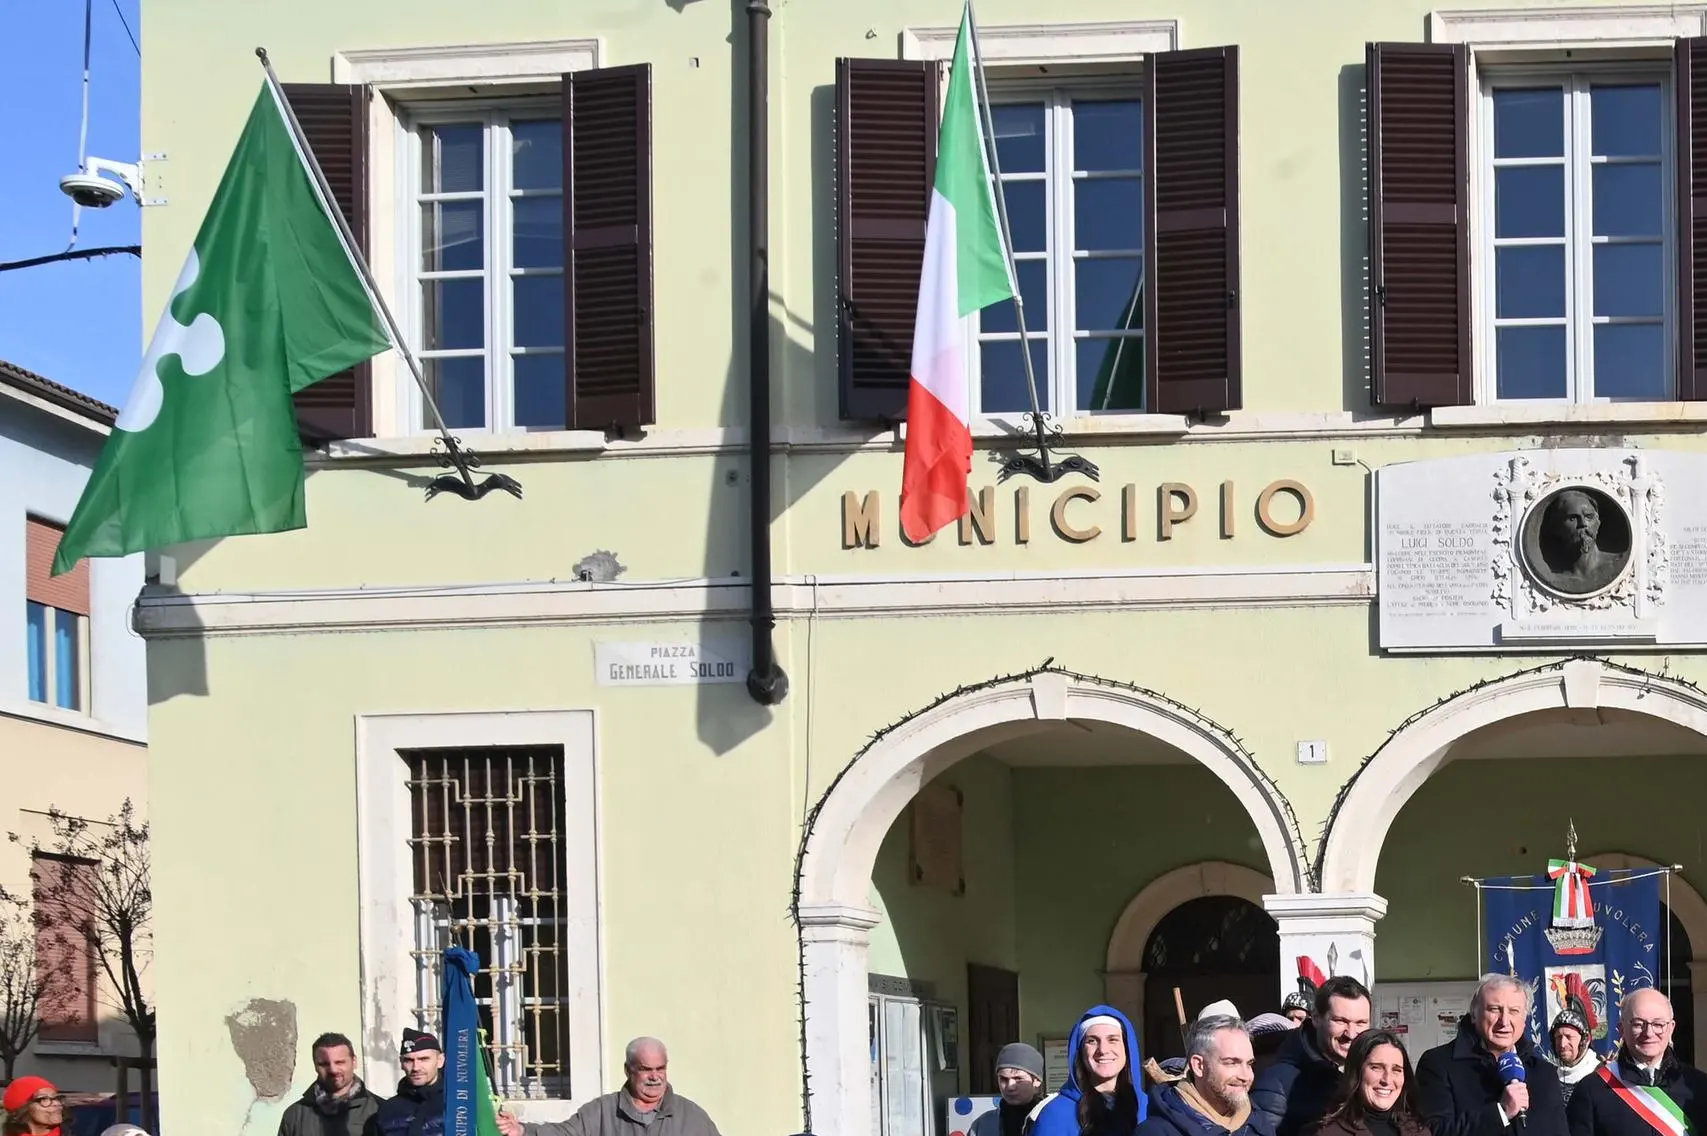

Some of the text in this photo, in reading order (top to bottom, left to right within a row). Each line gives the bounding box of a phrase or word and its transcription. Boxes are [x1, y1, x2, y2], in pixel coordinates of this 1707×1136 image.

[843, 478, 1315, 549] MNICIPIO
[651, 646, 696, 658] PIAZZA
[609, 663, 678, 680] GENERALE
[1309, 744, 1315, 758] 1
[1493, 902, 1655, 962] COMUNE UVOLERA
[456, 1028, 469, 1083] NUVOLERA
[456, 1089, 469, 1100] DI
